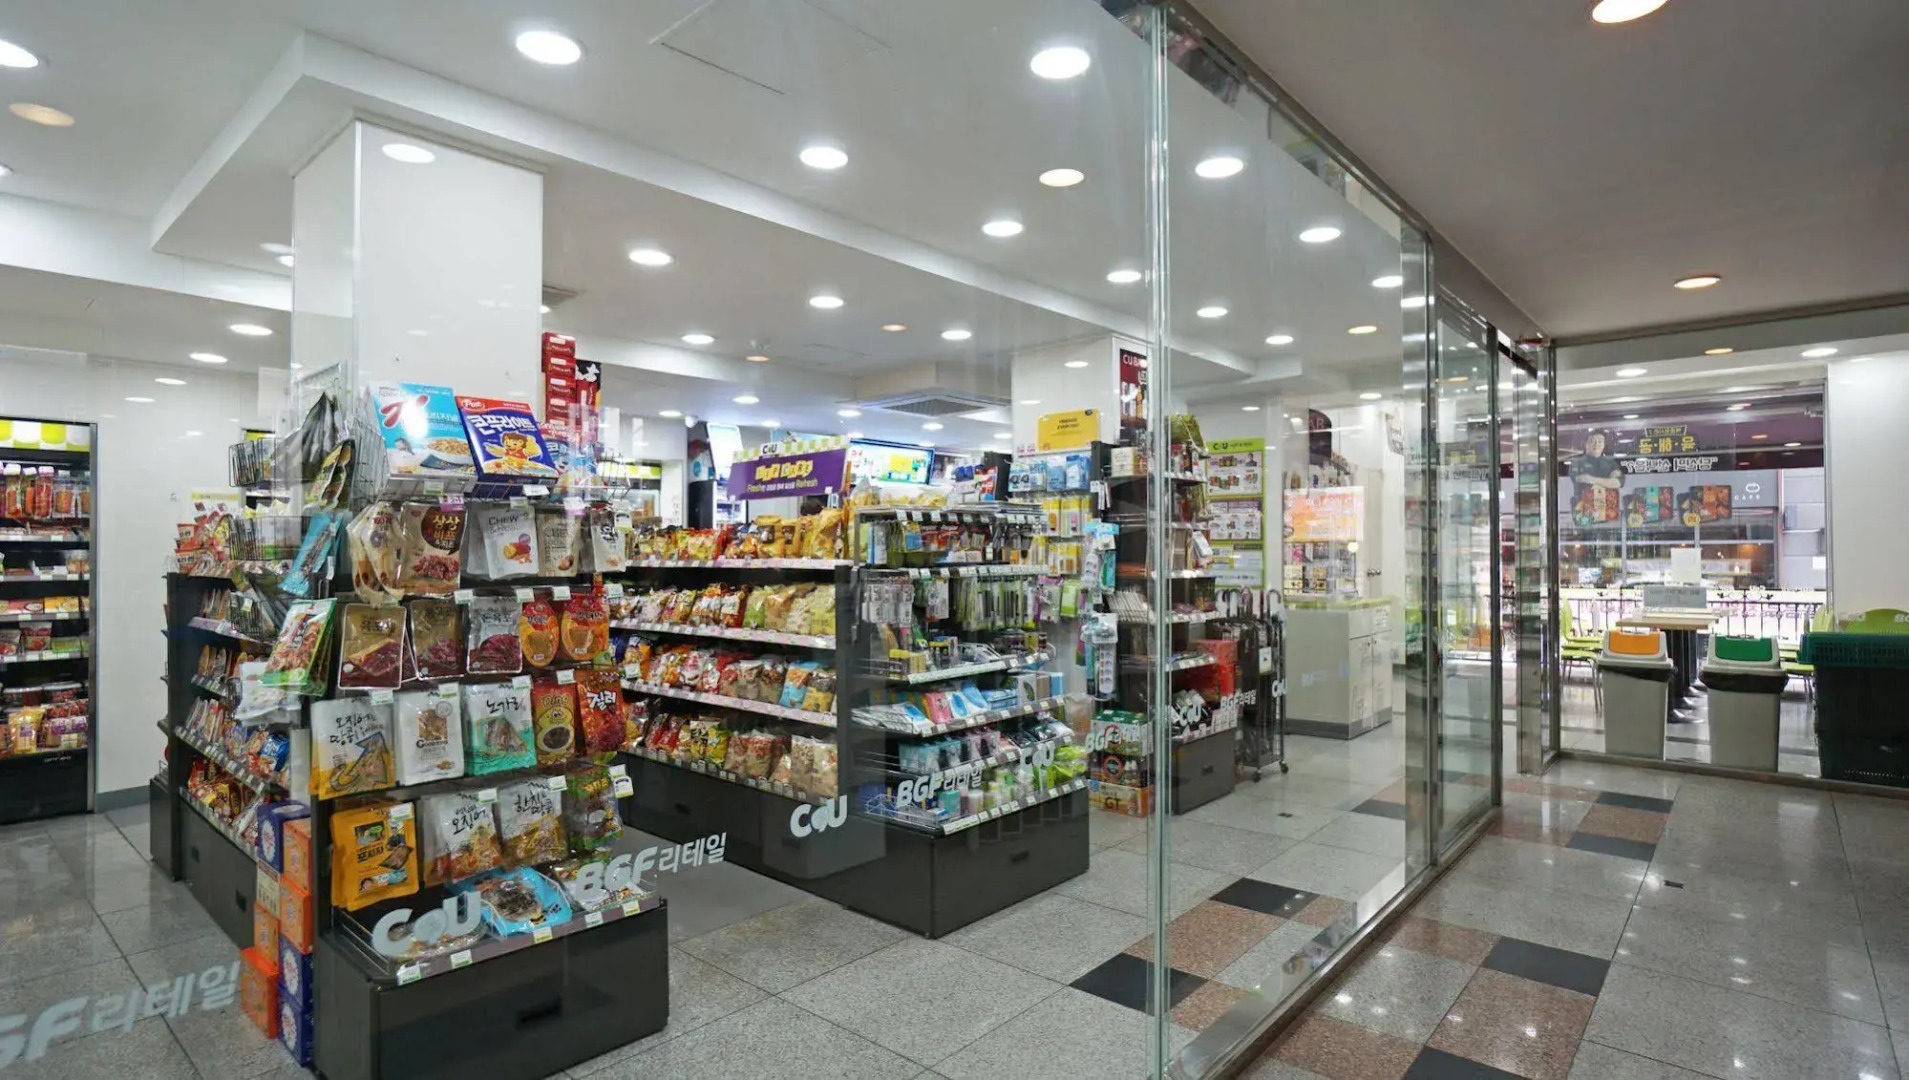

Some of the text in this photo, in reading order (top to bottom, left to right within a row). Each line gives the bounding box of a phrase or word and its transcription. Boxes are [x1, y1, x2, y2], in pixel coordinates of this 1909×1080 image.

[466, 415, 535, 435] 콘푸라이트
[586, 690, 617, 711] 질러
[451, 809, 487, 834] 오징어
[790, 795, 848, 838] CU
[371, 890, 482, 957] CU
